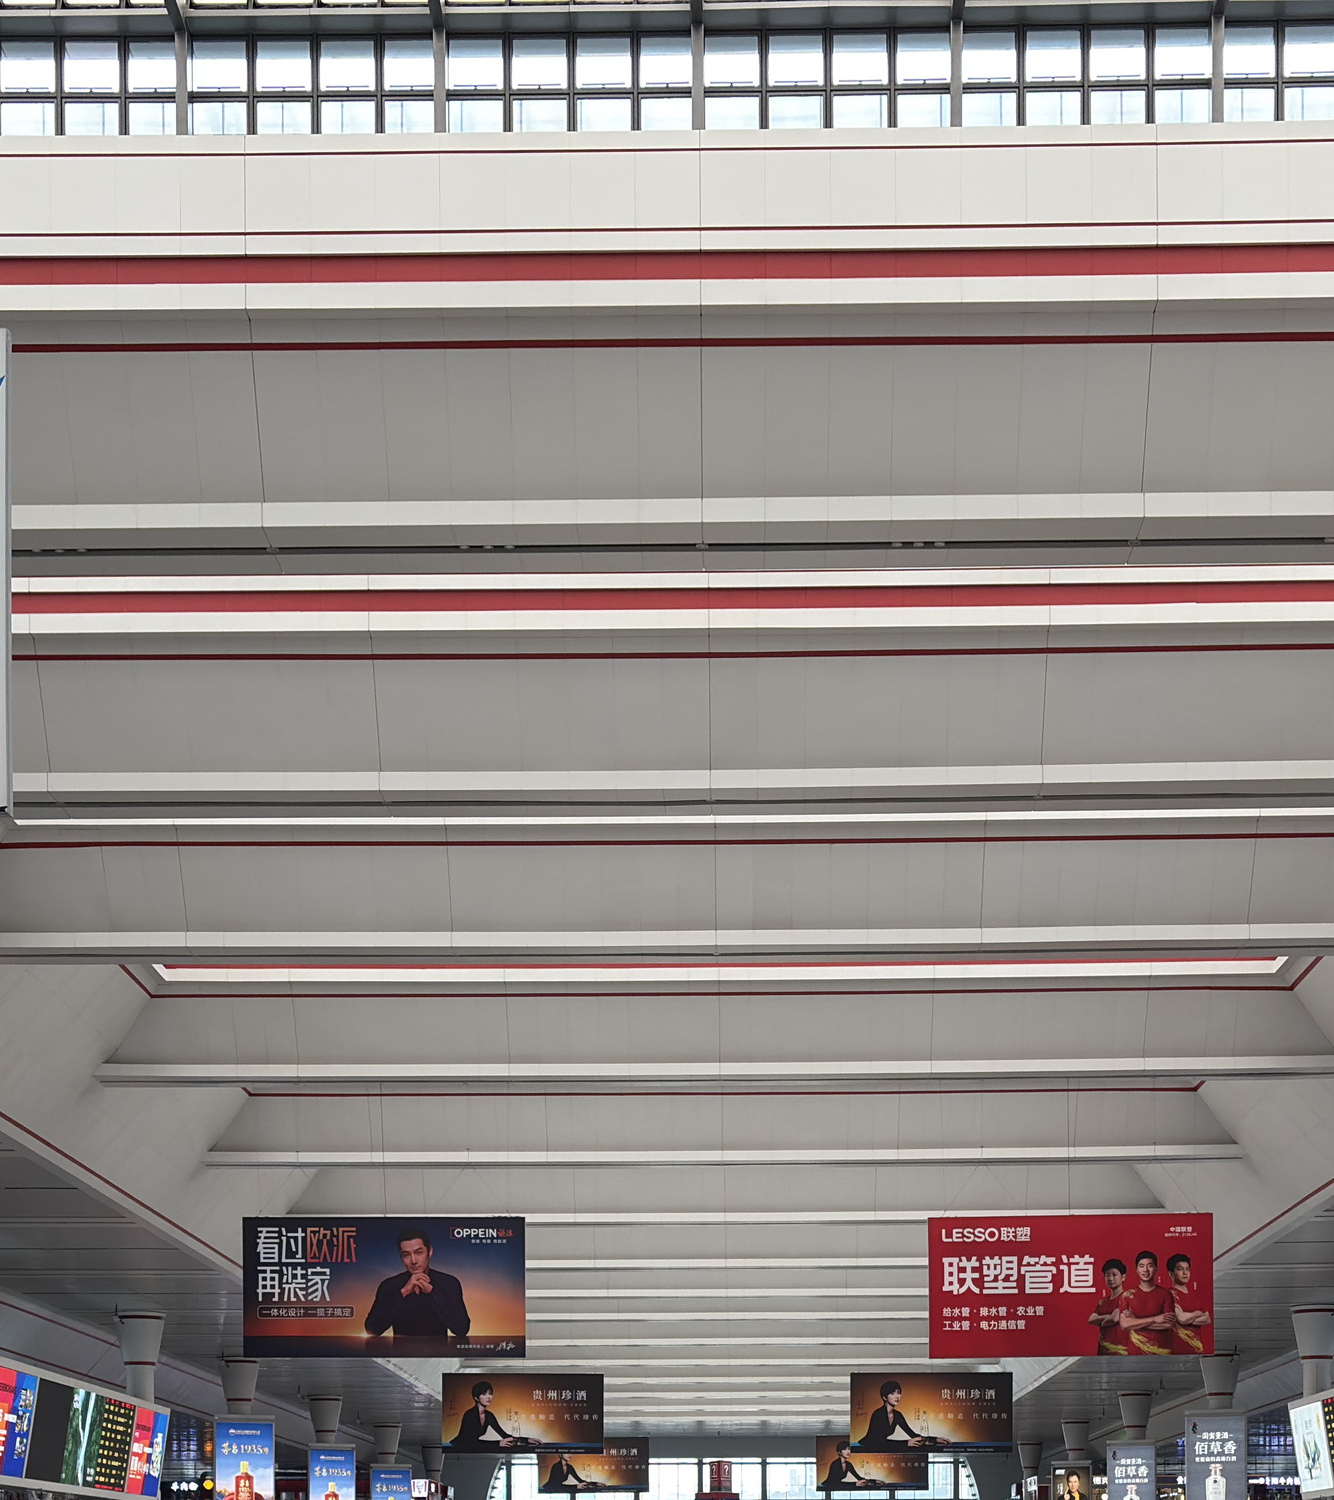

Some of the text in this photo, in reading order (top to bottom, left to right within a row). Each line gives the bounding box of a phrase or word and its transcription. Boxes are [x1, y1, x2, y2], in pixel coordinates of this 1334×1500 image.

[256, 1227, 357, 1263] 看过欧派
[454, 1228, 497, 1238] OPPEIN
[941, 1227, 1031, 1243] LESSO 联塑
[256, 1266, 331, 1302] 再装家
[942, 1254, 1096, 1295] 联塑管道
